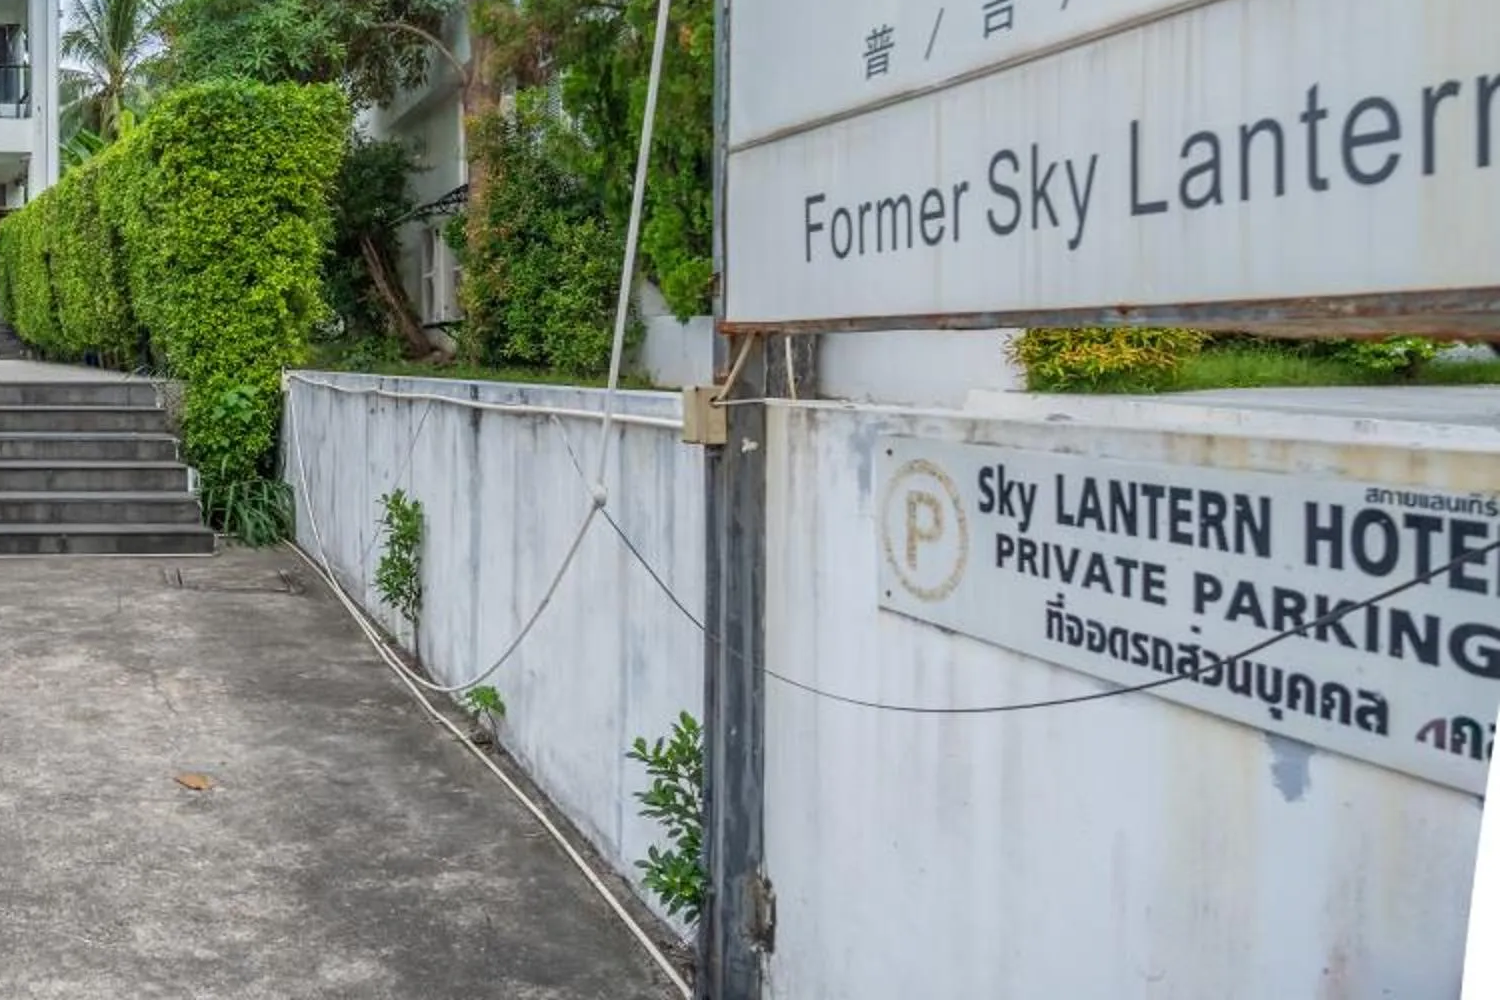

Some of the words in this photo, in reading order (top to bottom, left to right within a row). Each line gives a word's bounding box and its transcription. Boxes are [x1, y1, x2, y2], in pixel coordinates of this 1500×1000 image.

[803, 179, 969, 263] Former
[986, 142, 1099, 251] Sky
[1055, 473, 1273, 559] LANTERN
[1304, 500, 1500, 598] HOTE
[995, 533, 1168, 607] PRIVATE
[1192, 571, 1500, 681] PARKING
